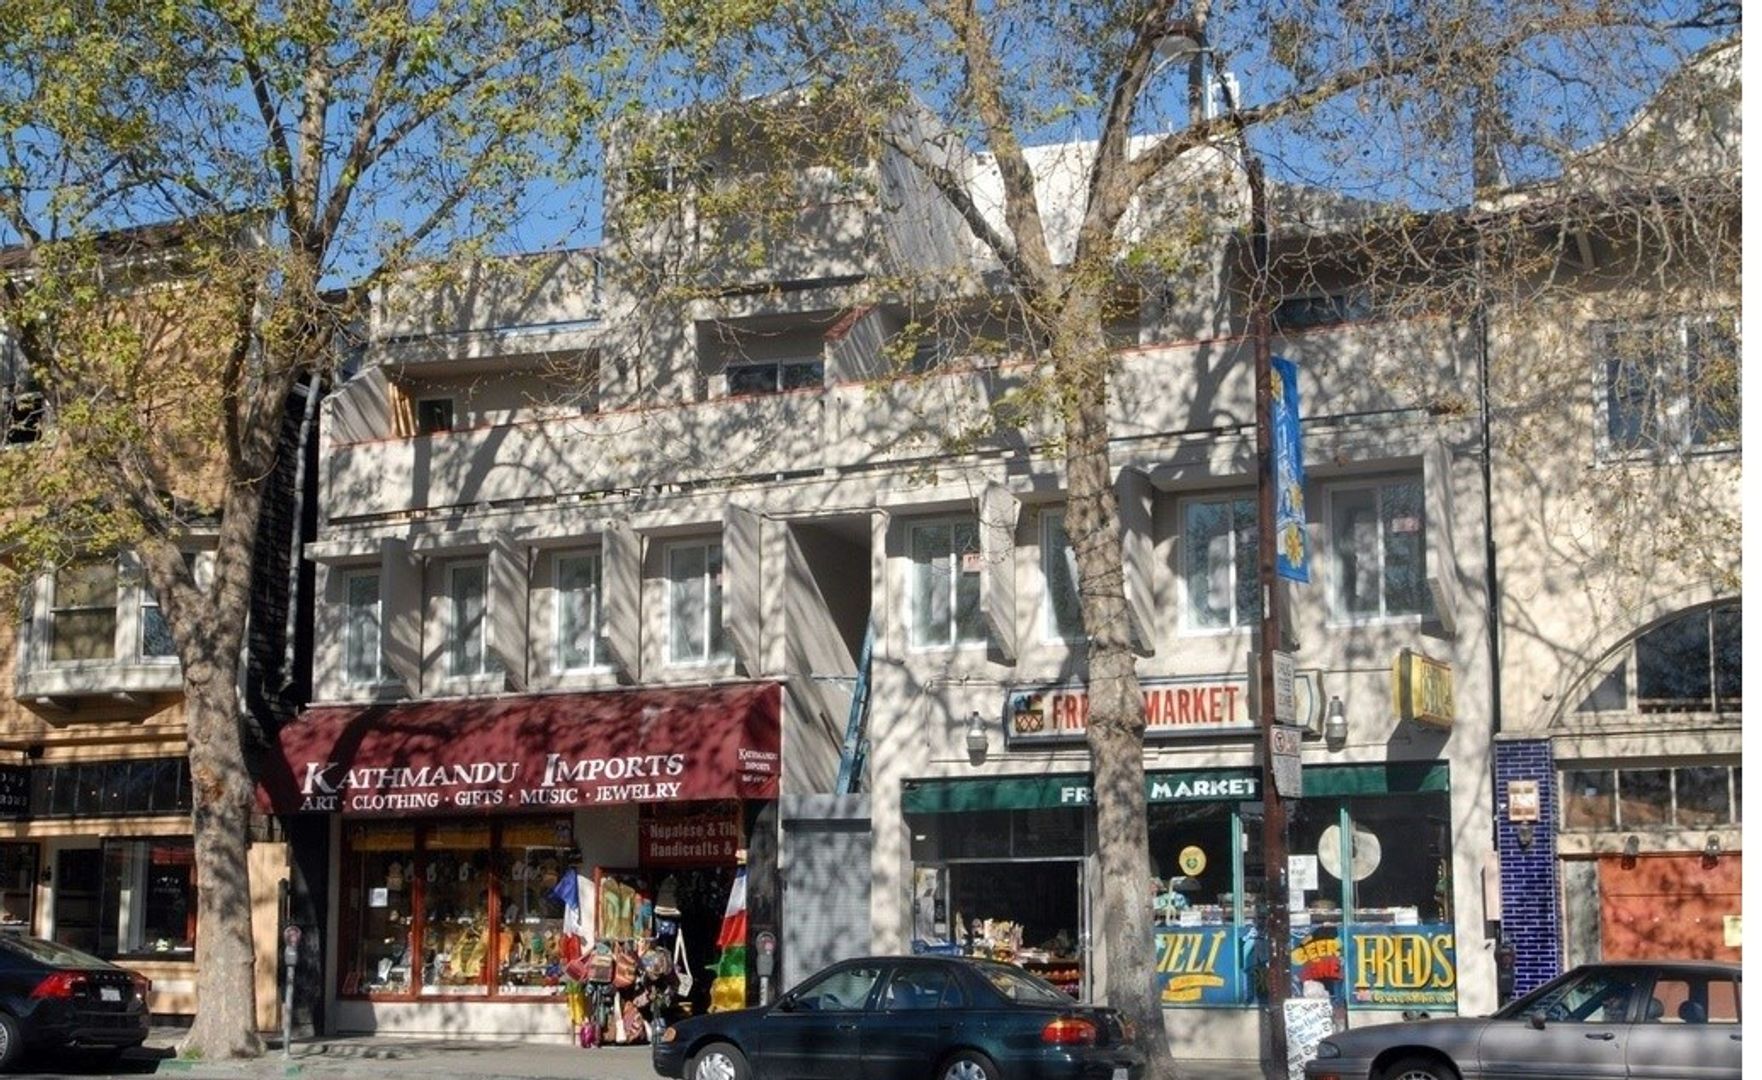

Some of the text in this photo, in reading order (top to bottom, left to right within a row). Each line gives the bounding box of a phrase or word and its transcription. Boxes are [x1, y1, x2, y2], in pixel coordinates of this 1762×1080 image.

[1143, 686, 1239, 725] MARKET
[301, 753, 685, 794] KATHMANDU IMPORTS
[300, 782, 682, 811] ART CLOTHING GIFTS MUSIC JEWELRY
[1151, 778, 1258, 799] MARKET
[650, 823, 703, 840] Nepalese
[707, 822, 716, 837] &
[650, 841, 732, 857] Handicrafts &
